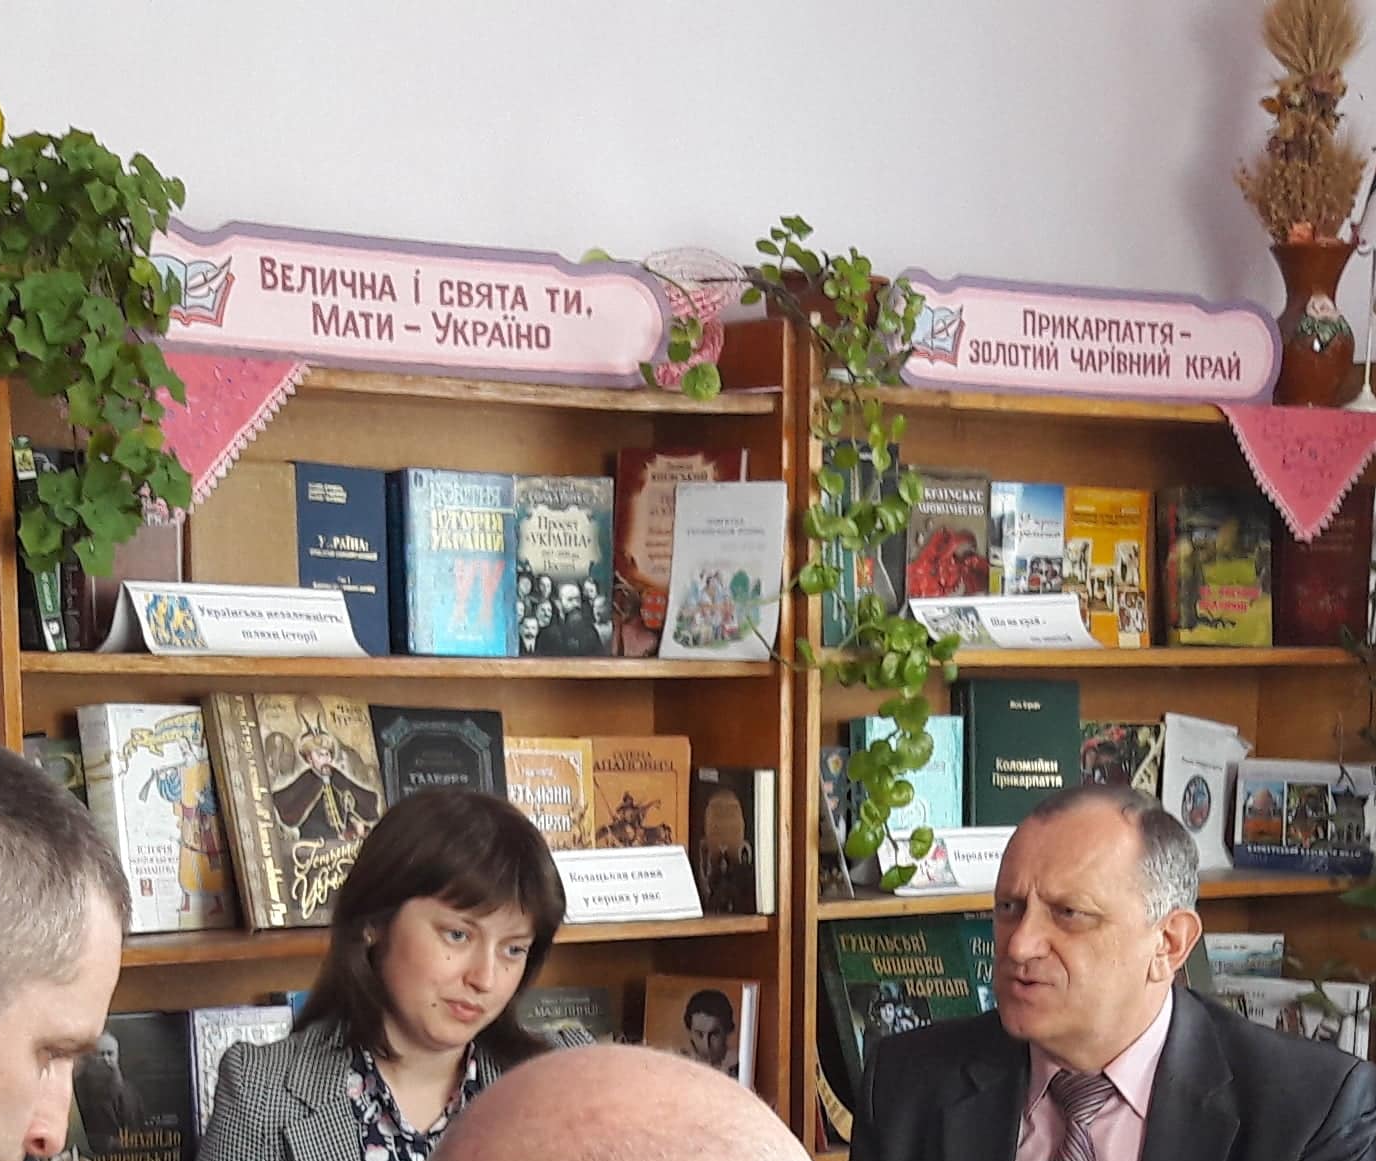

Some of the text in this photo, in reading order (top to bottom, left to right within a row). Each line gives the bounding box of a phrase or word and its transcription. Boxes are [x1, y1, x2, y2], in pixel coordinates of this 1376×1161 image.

[438, 280, 526, 313] СВЯТА
[311, 303, 394, 341] МАТИ
[431, 311, 552, 350] УКРАЇНО
[1022, 309, 1174, 346] ПРИКАРПАТТЯ
[969, 338, 1060, 372] ЗОЛОТИЙ
[1185, 351, 1242, 381] КРАЙ
[197, 606, 264, 620] Українська
[995, 756, 1059, 773] Коломийки
[992, 772, 1063, 790] Прикарпаття
[839, 929, 927, 953] ГУЦУЛЬСЬКІ
